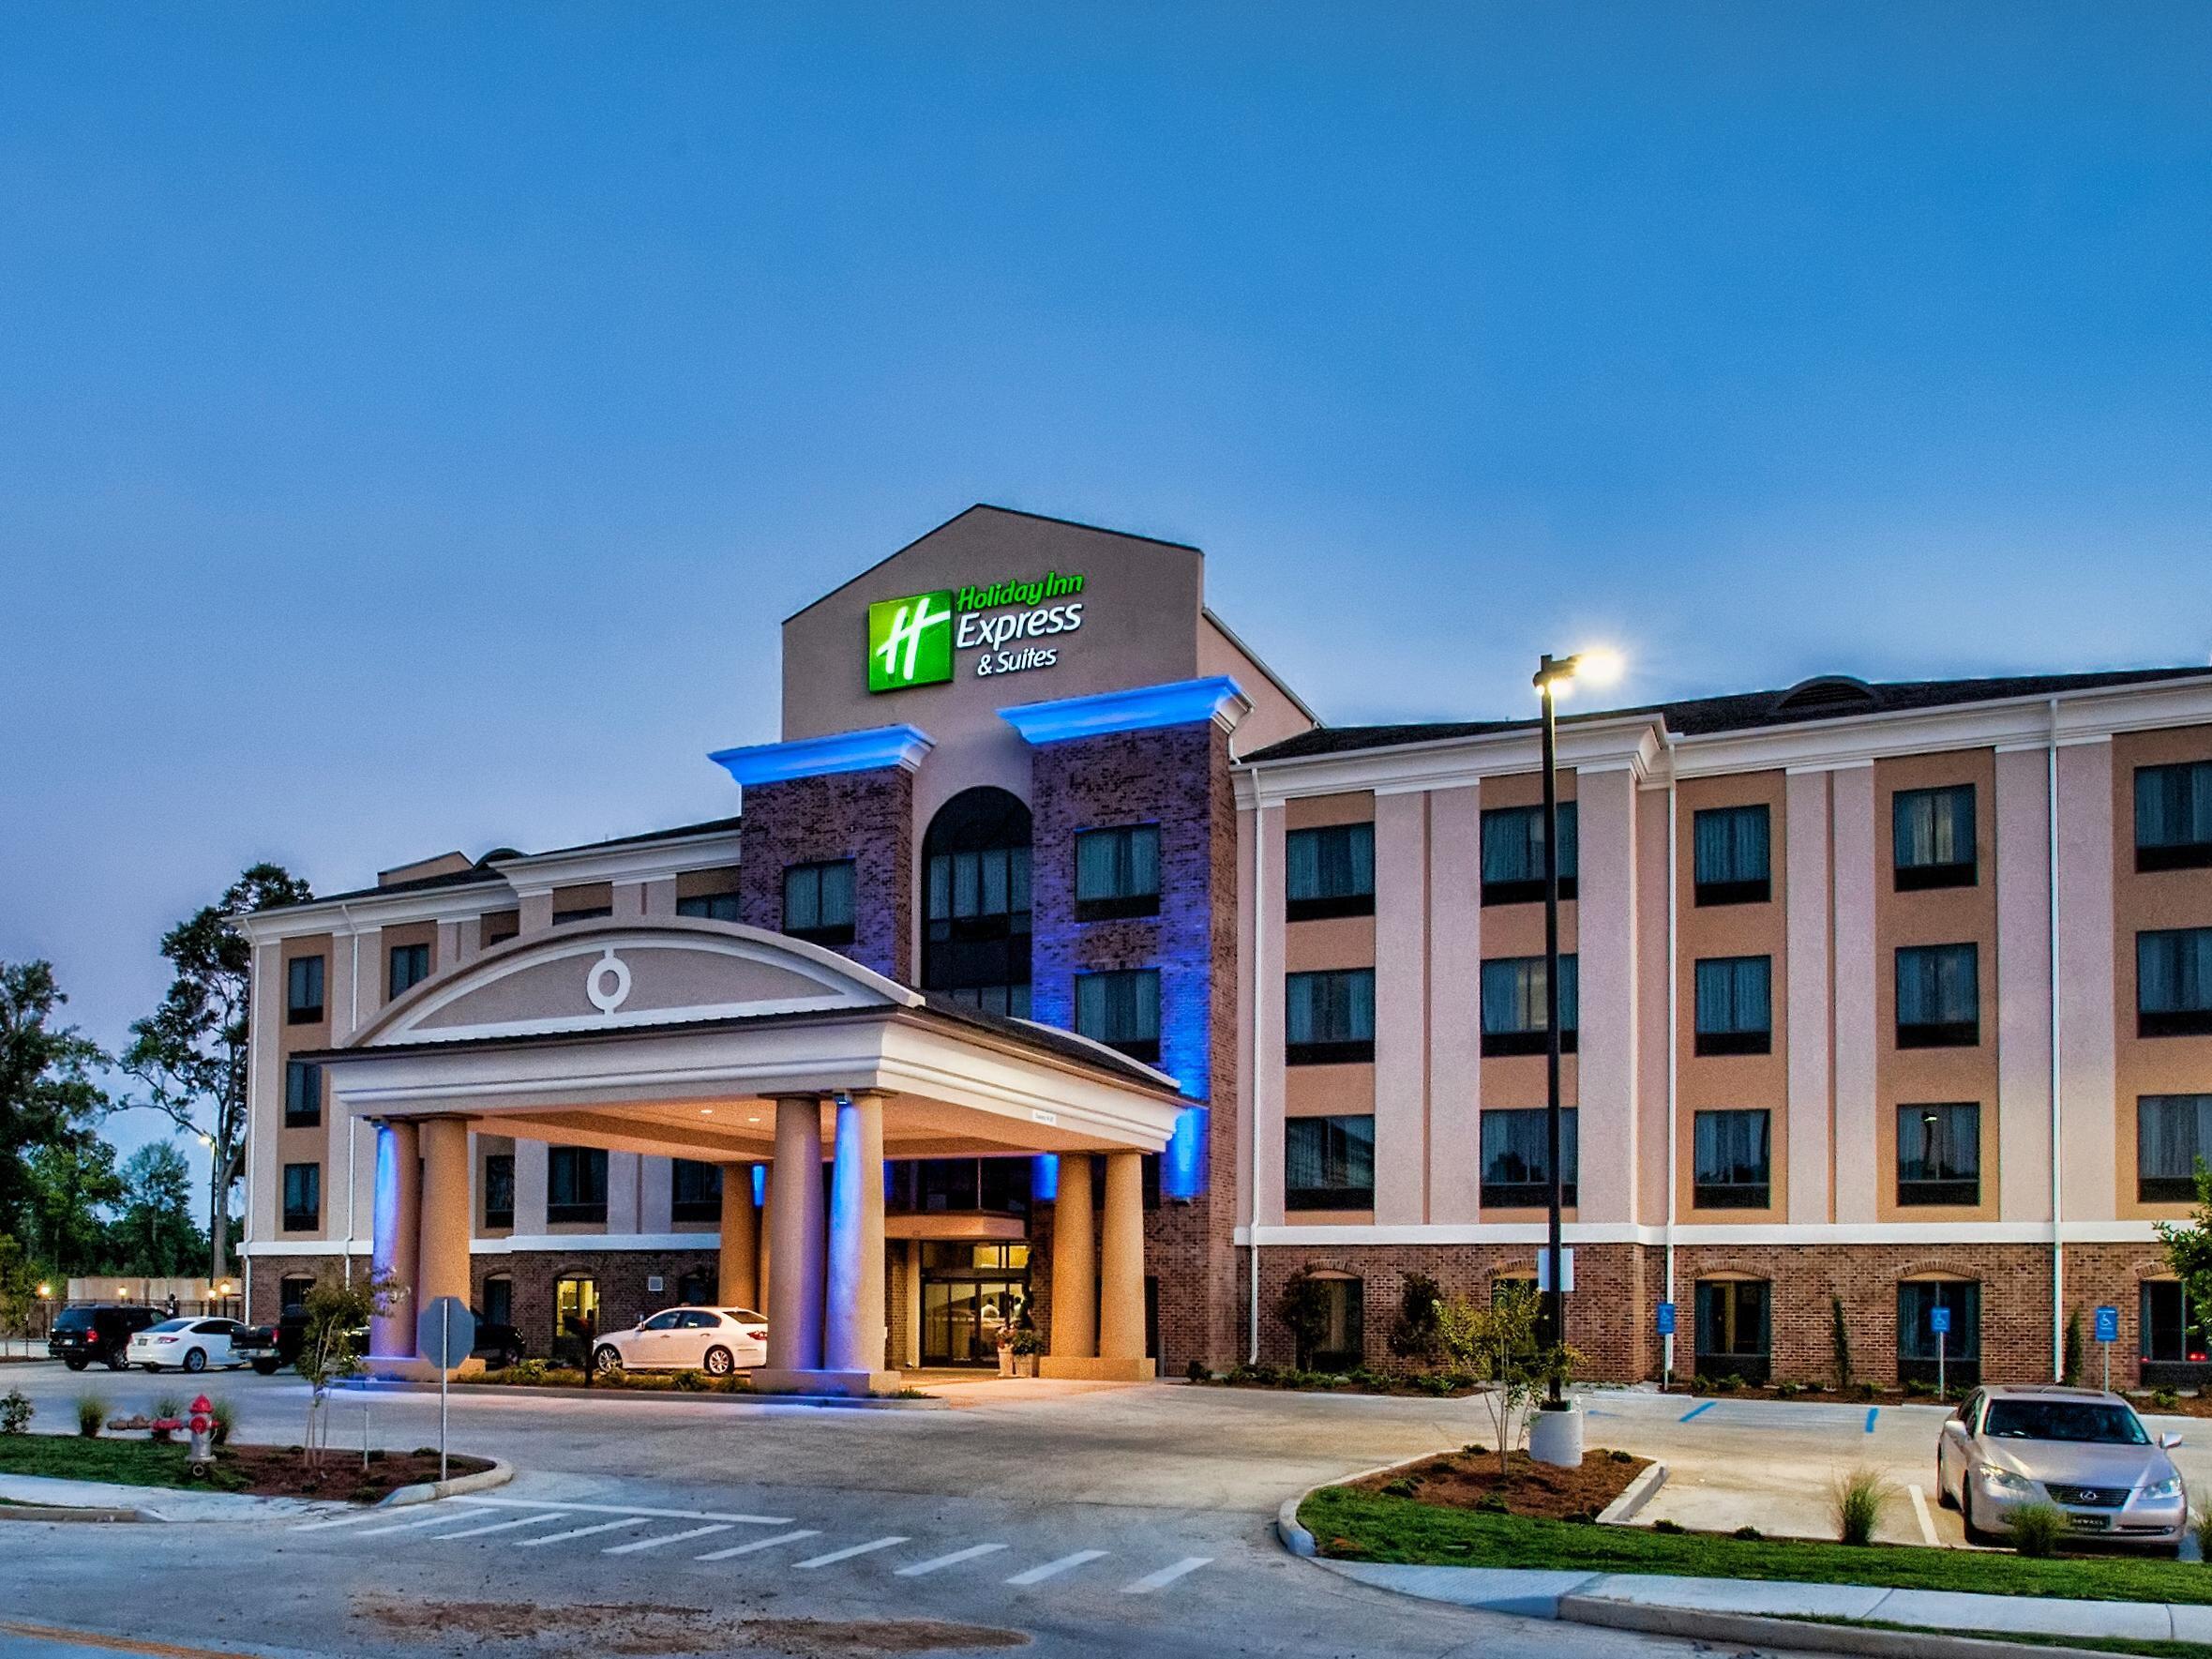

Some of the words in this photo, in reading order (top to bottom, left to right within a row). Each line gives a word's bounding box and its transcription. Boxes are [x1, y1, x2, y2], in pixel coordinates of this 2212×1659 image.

[957, 580, 1044, 611] Holiday
[1046, 571, 1084, 597] Inn
[956, 603, 1083, 651] Express
[977, 654, 992, 676] &
[996, 647, 1058, 673] Suites
